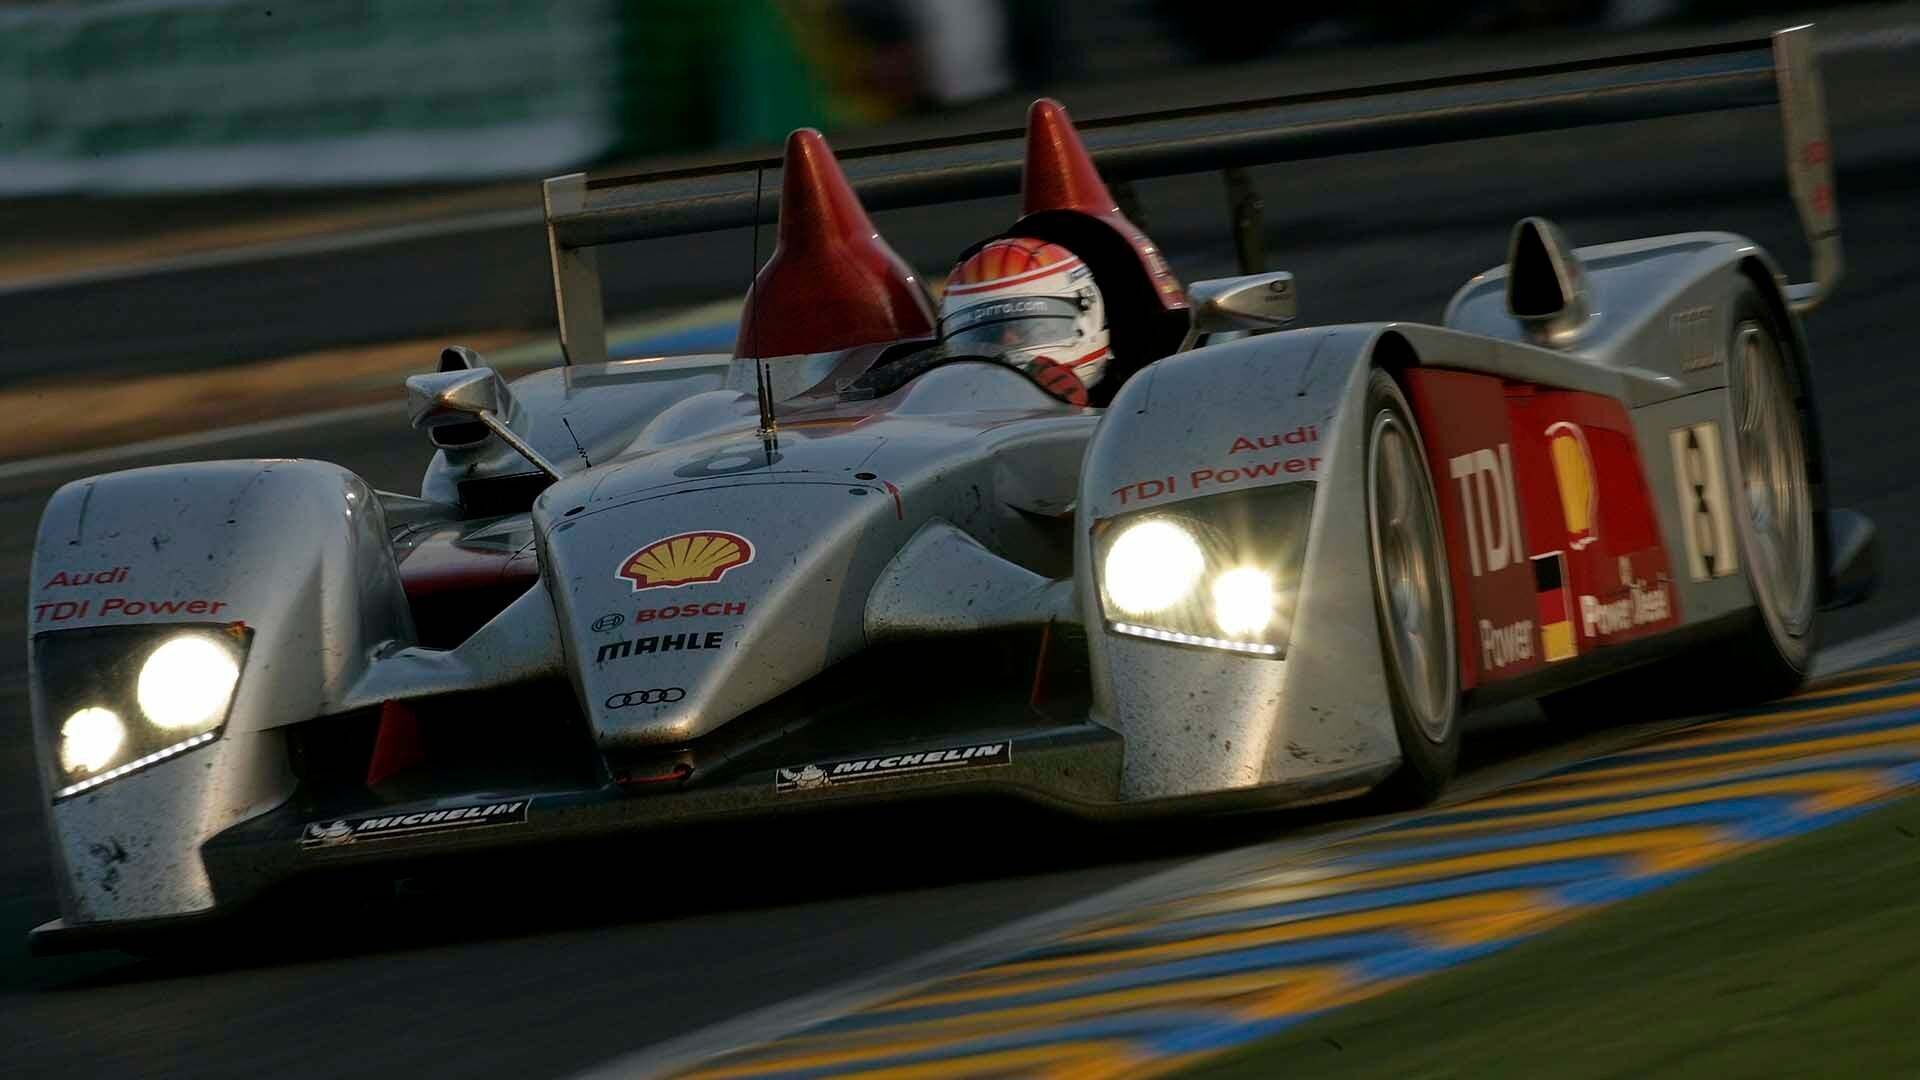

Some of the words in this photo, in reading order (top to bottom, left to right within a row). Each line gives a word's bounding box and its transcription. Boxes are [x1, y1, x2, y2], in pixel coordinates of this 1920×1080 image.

[1228, 425, 1319, 454] Audi
[1111, 476, 1176, 505] TDI
[1190, 457, 1323, 489] Power
[1450, 443, 1525, 577] TDI
[42, 567, 130, 590] Audi
[33, 600, 89, 624] TDI
[99, 597, 228, 617] Power
[635, 602, 746, 624] BOSCH
[596, 631, 724, 663] MAHLE
[832, 743, 1004, 774] MICHELIN
[357, 802, 524, 831] MICHELIN
